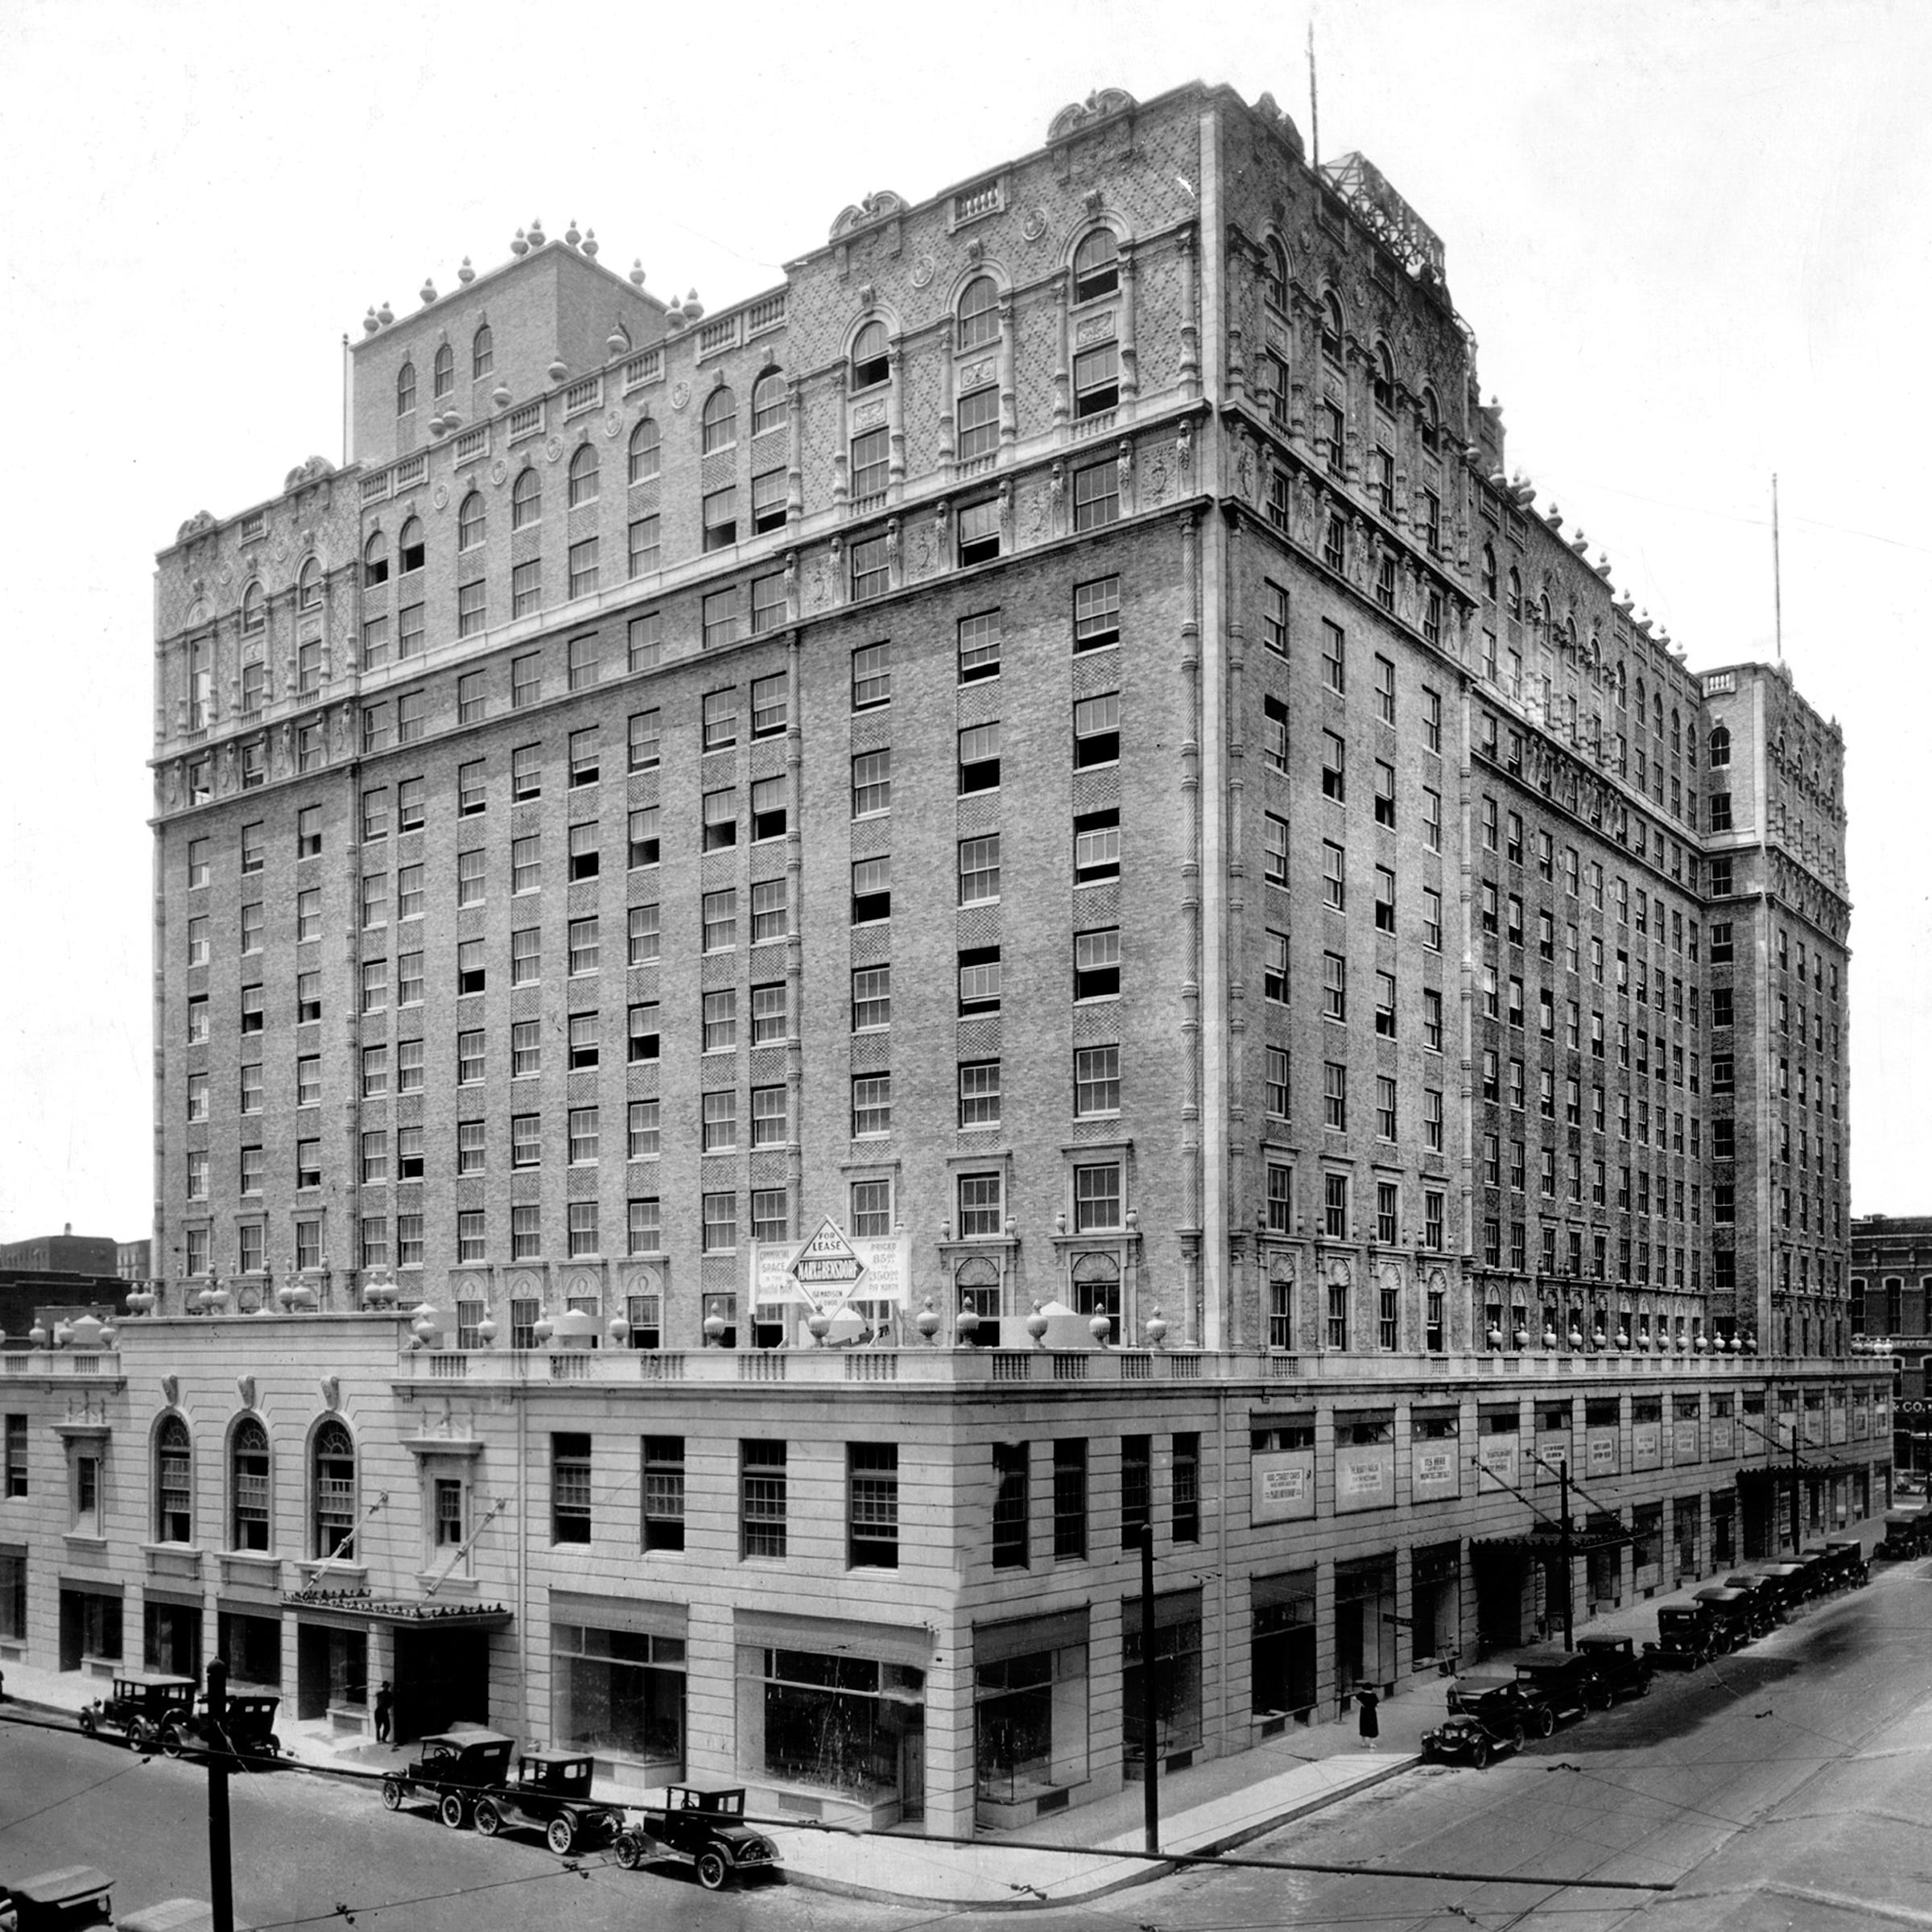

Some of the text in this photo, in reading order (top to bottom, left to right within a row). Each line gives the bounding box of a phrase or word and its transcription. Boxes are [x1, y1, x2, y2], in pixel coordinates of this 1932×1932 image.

[813, 1241, 841, 1251] LEASE
[762, 1261, 786, 1273] SPACE
[1902, 1401, 1926, 1413] CO.
